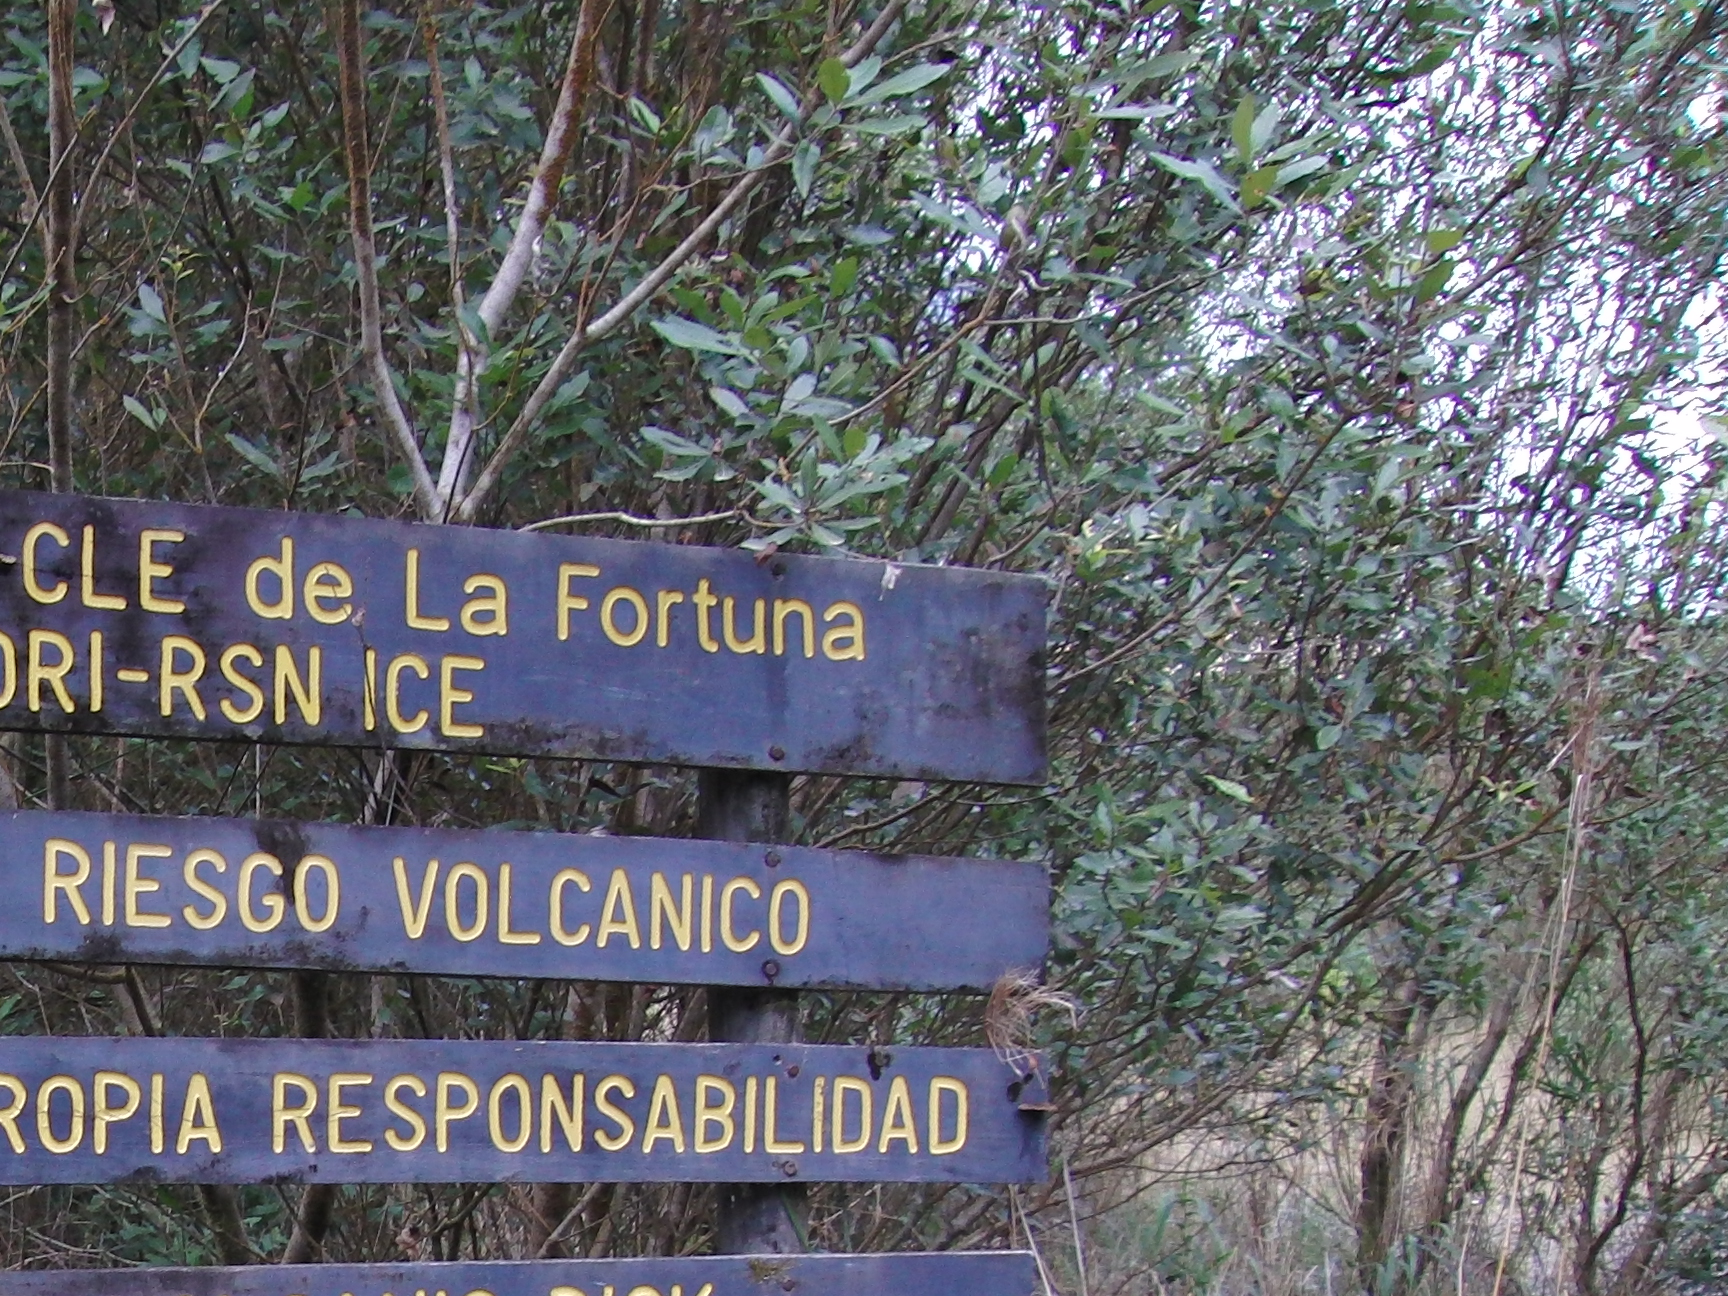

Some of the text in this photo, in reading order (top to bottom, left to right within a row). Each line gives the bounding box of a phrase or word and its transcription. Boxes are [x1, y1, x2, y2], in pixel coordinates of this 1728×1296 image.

[245, 536, 353, 624] de
[406, 548, 508, 636] La
[557, 562, 866, 659] Fortuna
[363, 647, 485, 738] ICE
[44, 838, 340, 930] RIESGO
[394, 857, 810, 954] VOLCANICO
[272, 1071, 969, 1153] RESPONSABILIDAD
